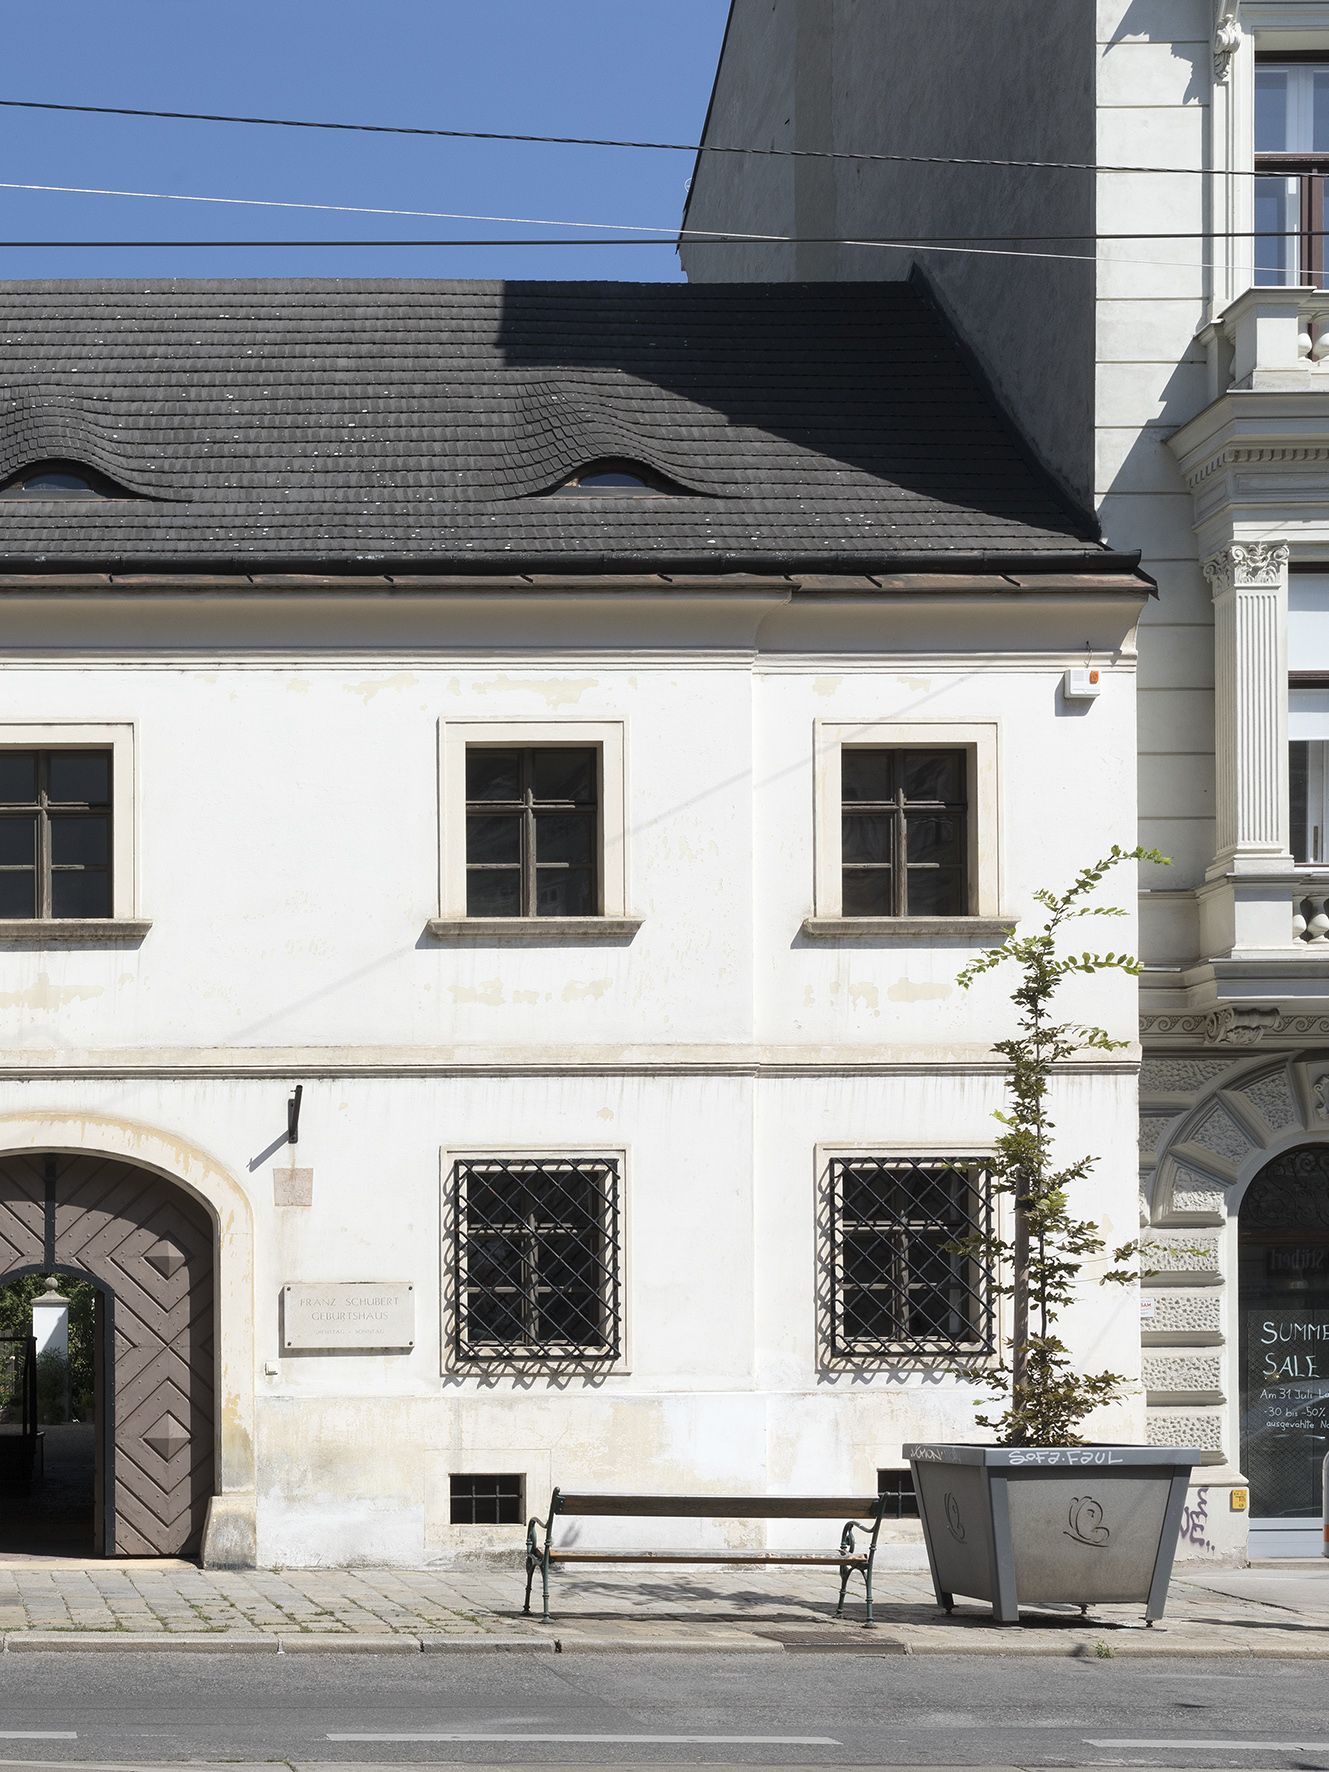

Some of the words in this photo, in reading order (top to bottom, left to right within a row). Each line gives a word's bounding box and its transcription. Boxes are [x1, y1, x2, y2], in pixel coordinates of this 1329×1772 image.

[300, 1297, 337, 1307] FRANZ
[345, 1296, 400, 1307] SCHUBERT
[311, 1311, 390, 1322] GEBURTSHAUS
[1262, 1352, 1320, 1378] SALE
[1259, 1388, 1277, 1399] Am
[1279, 1388, 1291, 1400] 31
[1294, 1388, 1313, 1400] Juli
[1285, 1407, 1298, 1418] bis
[1301, 1406, 1326, 1418] -50%
